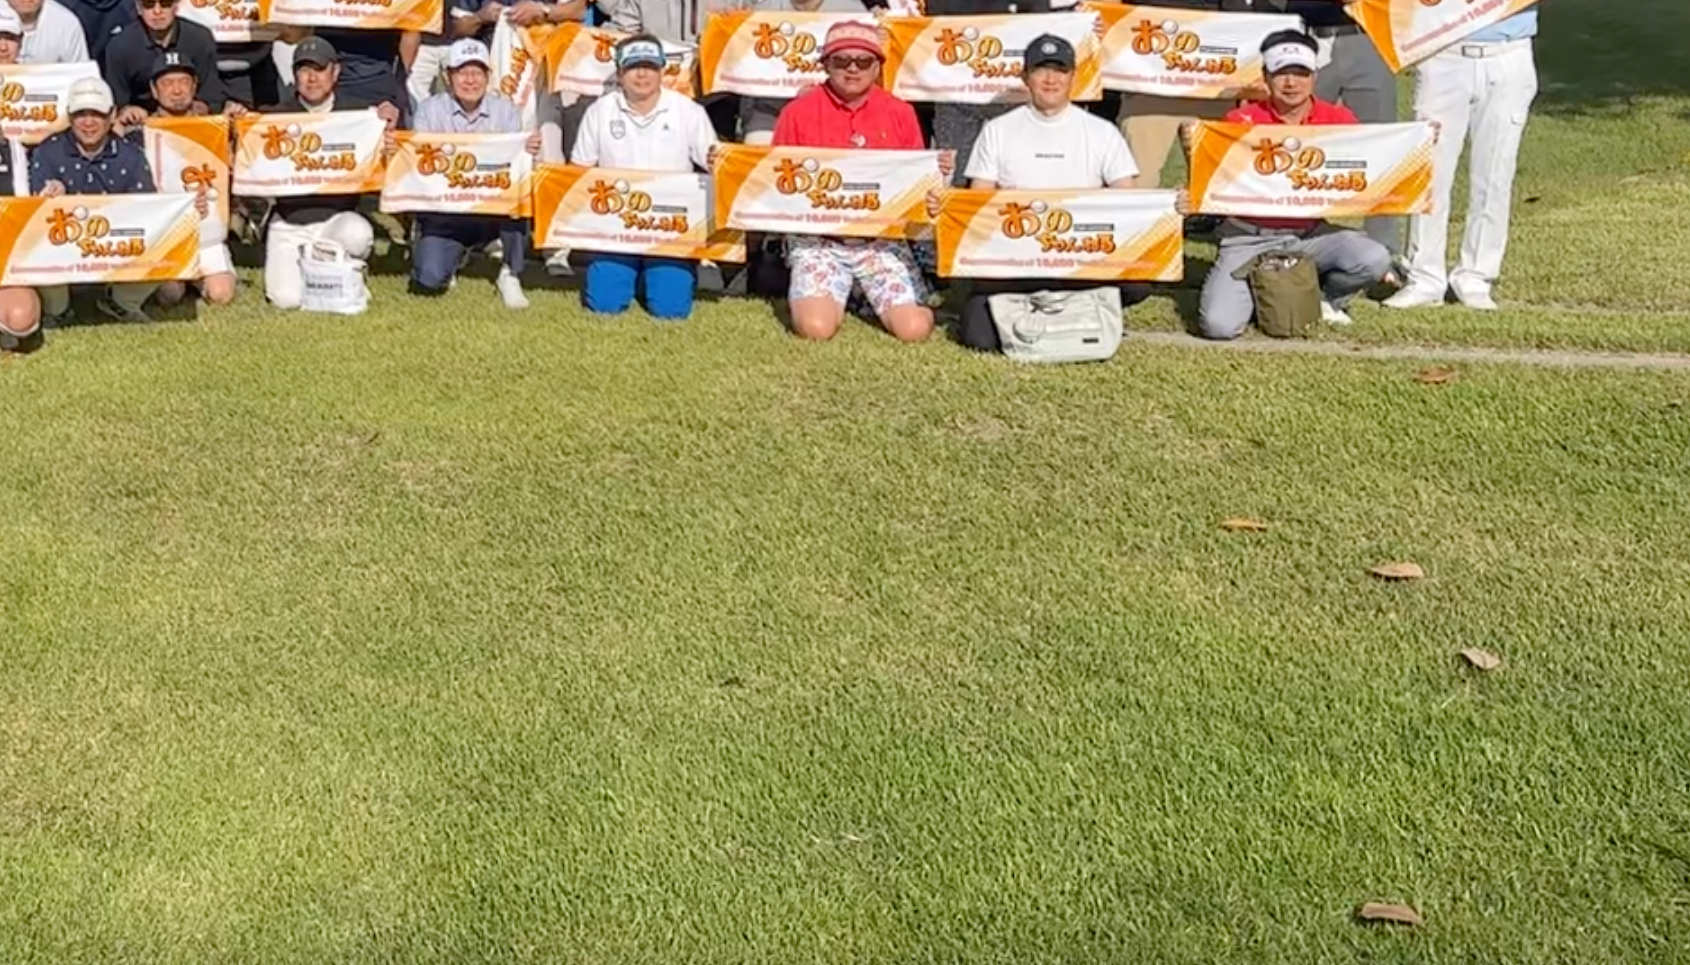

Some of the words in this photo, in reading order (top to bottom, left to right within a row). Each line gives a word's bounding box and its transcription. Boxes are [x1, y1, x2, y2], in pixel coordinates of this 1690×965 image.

[753, 21, 816, 57] おの
[934, 26, 1002, 65] おの
[1131, 19, 1199, 55] おの
[262, 123, 321, 160] おの
[1252, 136, 1325, 175] おの
[415, 144, 476, 176] おの
[774, 158, 842, 194] おの
[588, 179, 651, 215] おの
[46, 205, 109, 245] おの
[999, 199, 1073, 239] おの
